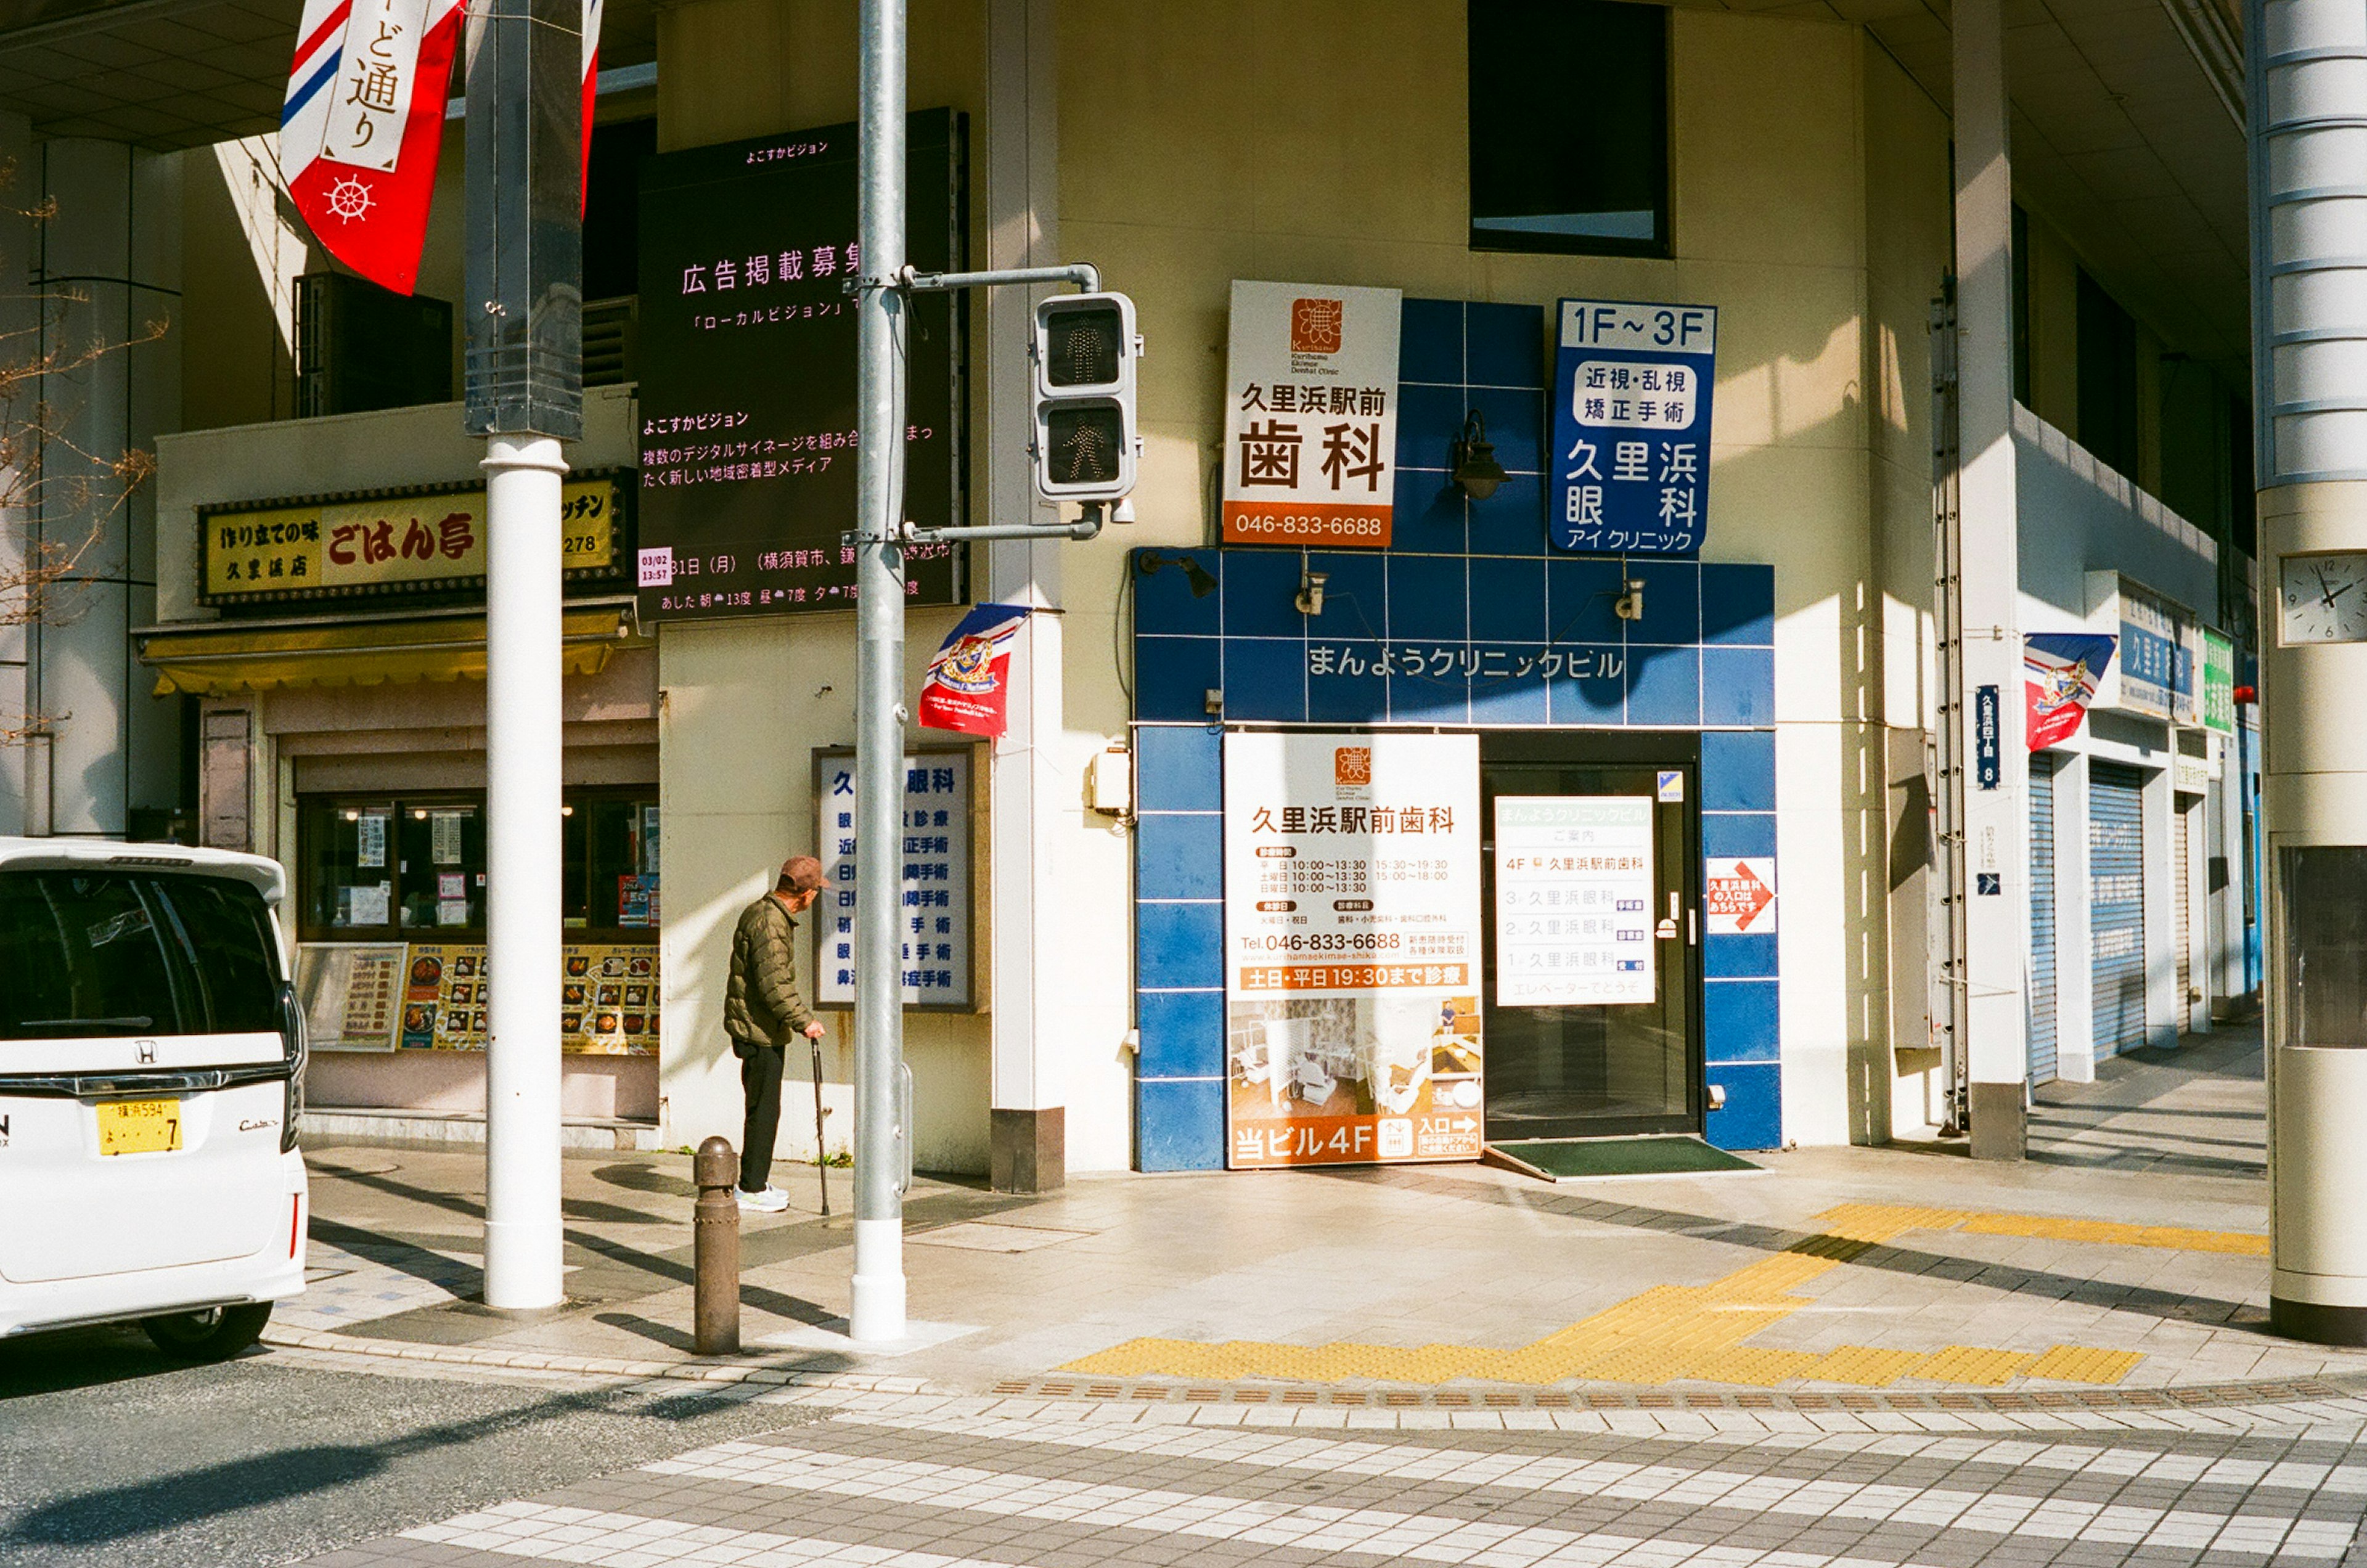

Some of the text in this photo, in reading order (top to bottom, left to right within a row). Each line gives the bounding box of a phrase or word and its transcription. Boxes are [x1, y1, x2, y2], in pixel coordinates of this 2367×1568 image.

[346, 0, 403, 148] ど通り
[746, 142, 828, 164] よこすかビジョン
[1585, 367, 1686, 393] 近視・乱視
[1240, 383, 1386, 417] 久里浜駅前
[1584, 398, 1684, 423] 矯正手術
[643, 412, 748, 435] よこすかビジョン
[1239, 419, 1385, 492] 歯科
[1566, 439, 1698, 484] 久里浜
[644, 457, 832, 488] たく新しい地域密着型メディア
[221, 520, 319, 549] 作り立ての味
[1236, 514, 1381, 536] 046-833-6688
[328, 513, 475, 565] ごはん亭
[565, 535, 595, 553] 278
[227, 555, 307, 581] 久里浜店
[642, 555, 668, 567] 03/02
[642, 570, 667, 581] 13:57
[661, 595, 695, 610] あした
[726, 590, 752, 606] 13度
[1309, 646, 1624, 679] まんようクリニックビル
[833, 768, 955, 795] 久眼科
[1984, 767, 1993, 782] 8
[1252, 806, 1454, 835] 久里浜駅前歯科
[1501, 808, 1648, 823] まんようクリニックビル
[1554, 830, 1595, 843] ご案内
[1506, 857, 1644, 870] 4F 久里浜駅前歯科
[1261, 872, 1288, 882] 土曜日
[1261, 883, 1288, 893] 日曜日
[1529, 890, 1614, 906] 久里浜眼科
[1714, 891, 1753, 902] の入口は
[1529, 919, 1614, 936] 久里浜眼科
[1241, 933, 1400, 950] Tel. 046-833-6688
[1530, 952, 1614, 968] 久里浜眼科
[167, 1119, 177, 1145] 7
[1418, 1117, 1450, 1135] 入口
